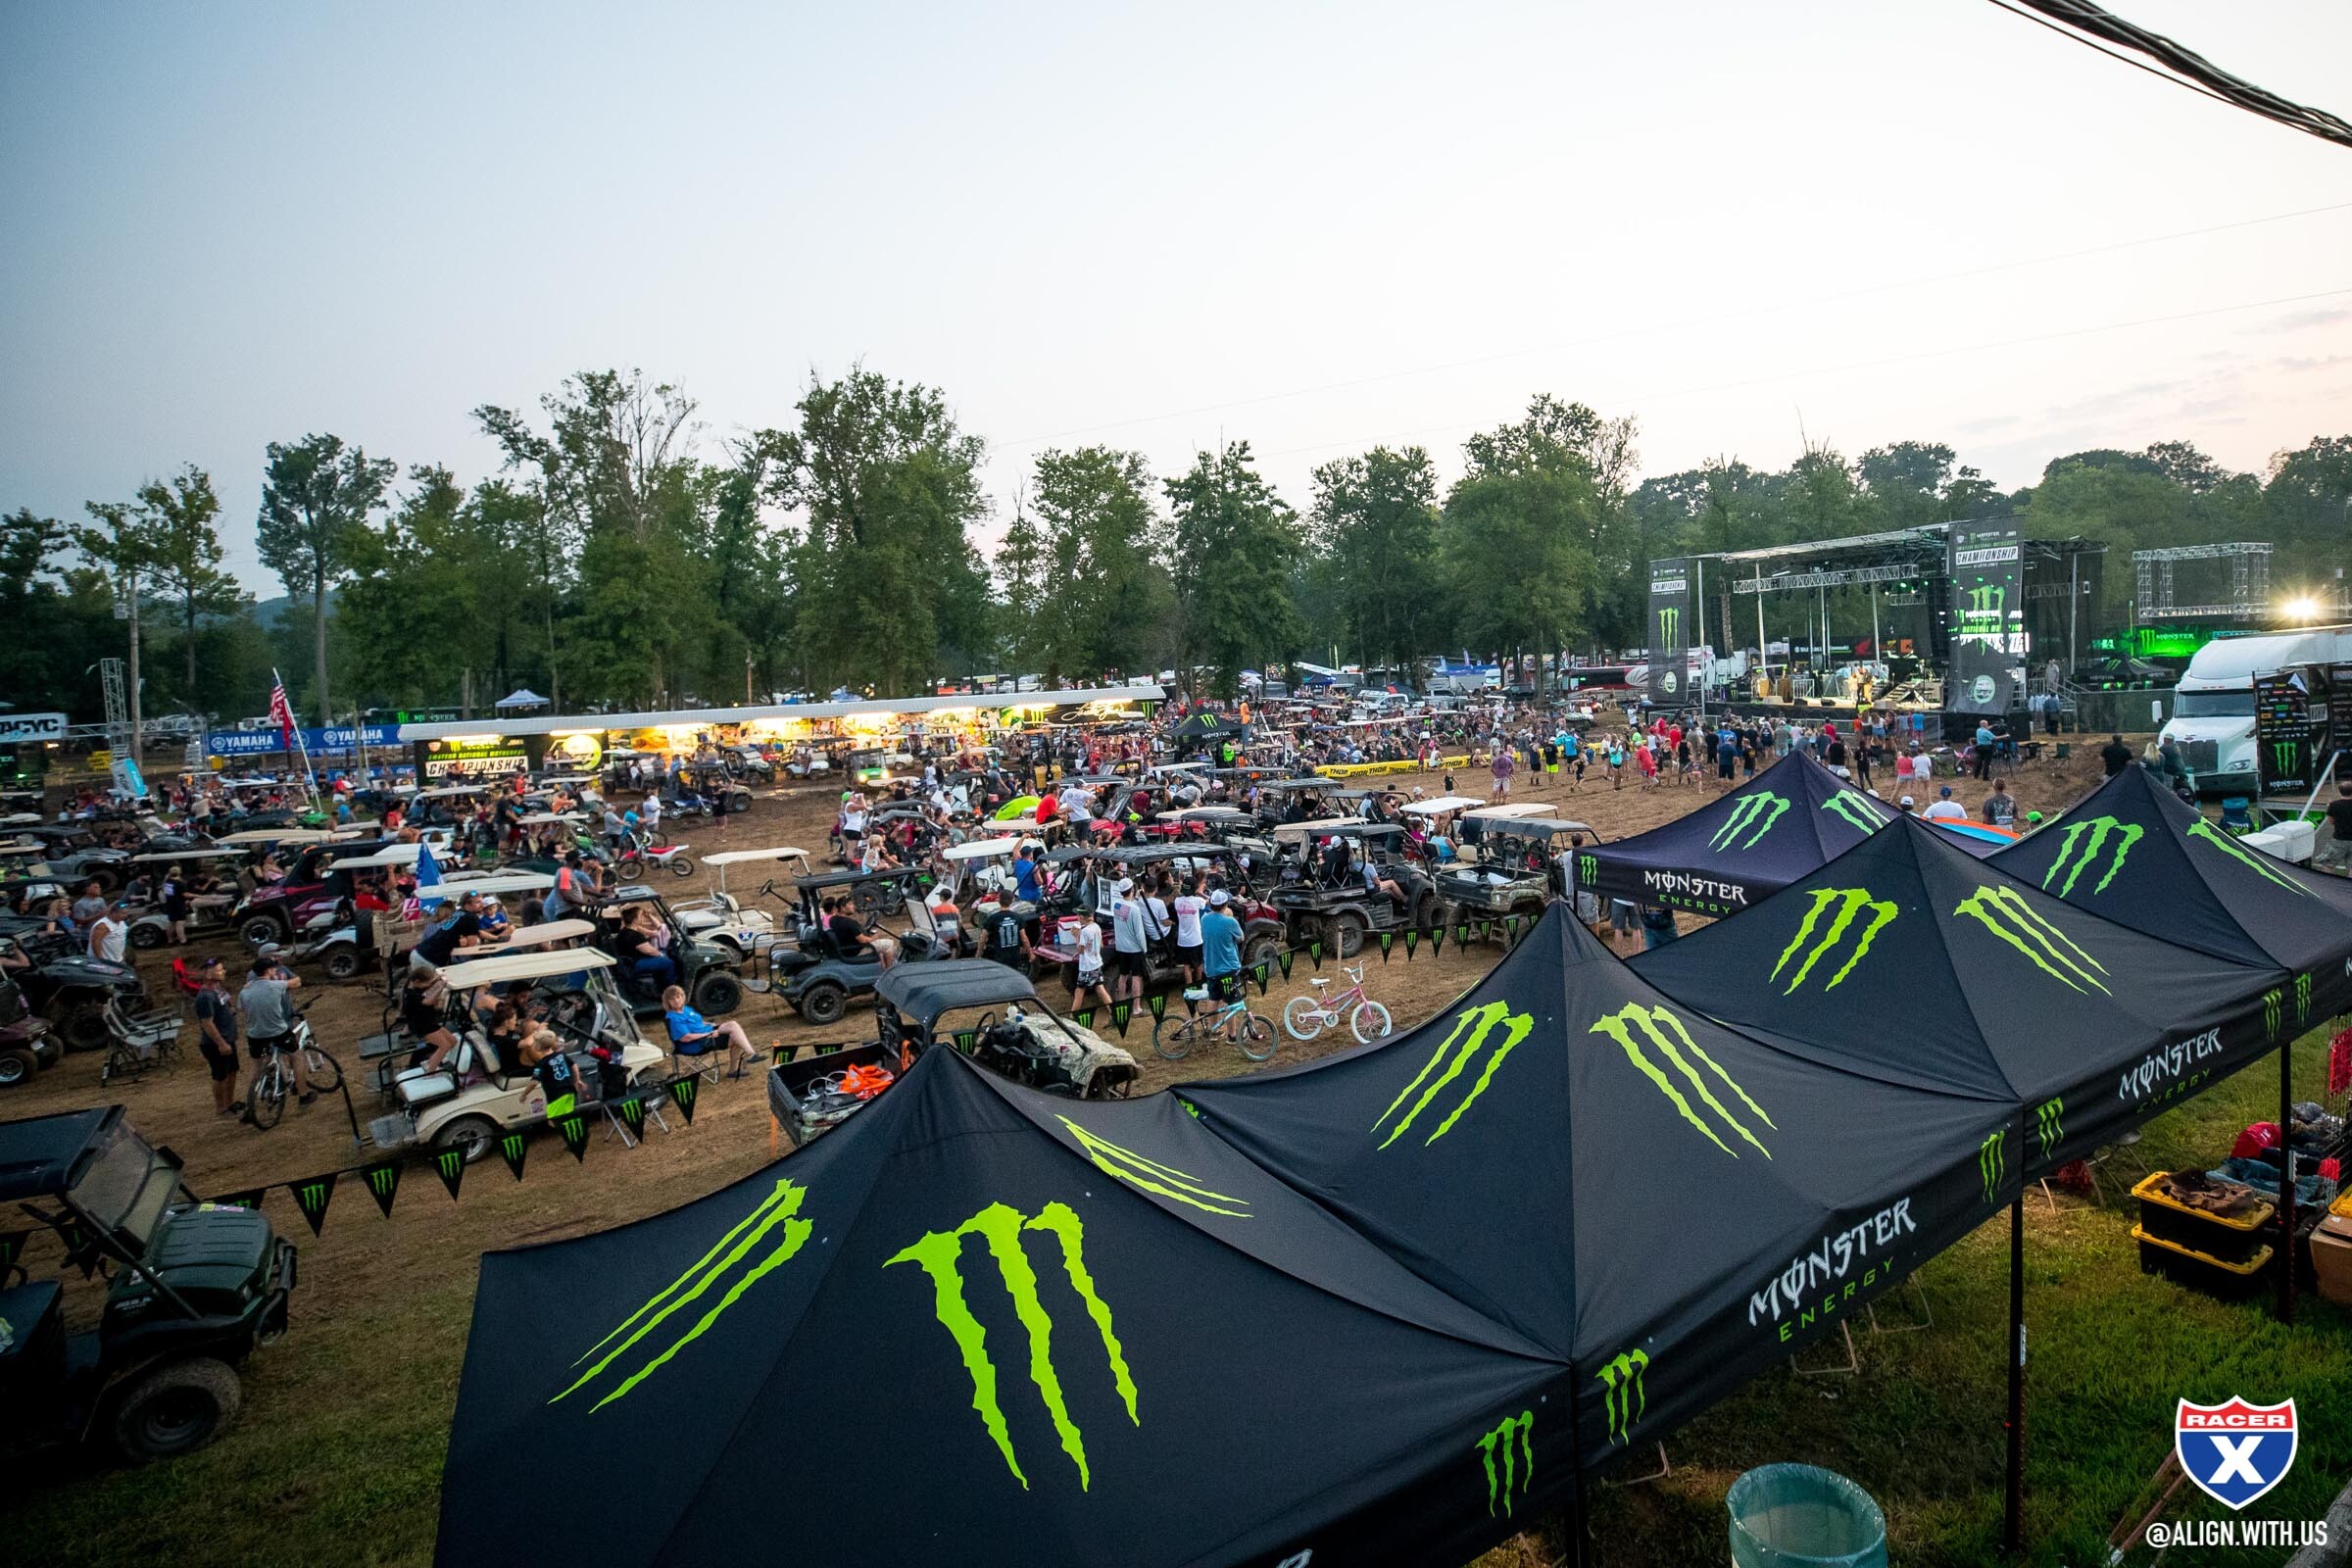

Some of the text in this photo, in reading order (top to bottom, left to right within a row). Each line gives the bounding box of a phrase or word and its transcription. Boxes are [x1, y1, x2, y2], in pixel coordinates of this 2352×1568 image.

[225, 735, 273, 748] YAMAHA
[1644, 870, 1748, 905] MONSTER
[1659, 894, 1731, 914] ENERGY
[2119, 1027, 2224, 1101] MONSTER
[2136, 1067, 2211, 1114] ENERGY
[1748, 1197, 1917, 1327] MONSTER
[1780, 1255, 1894, 1343] ENERGY
